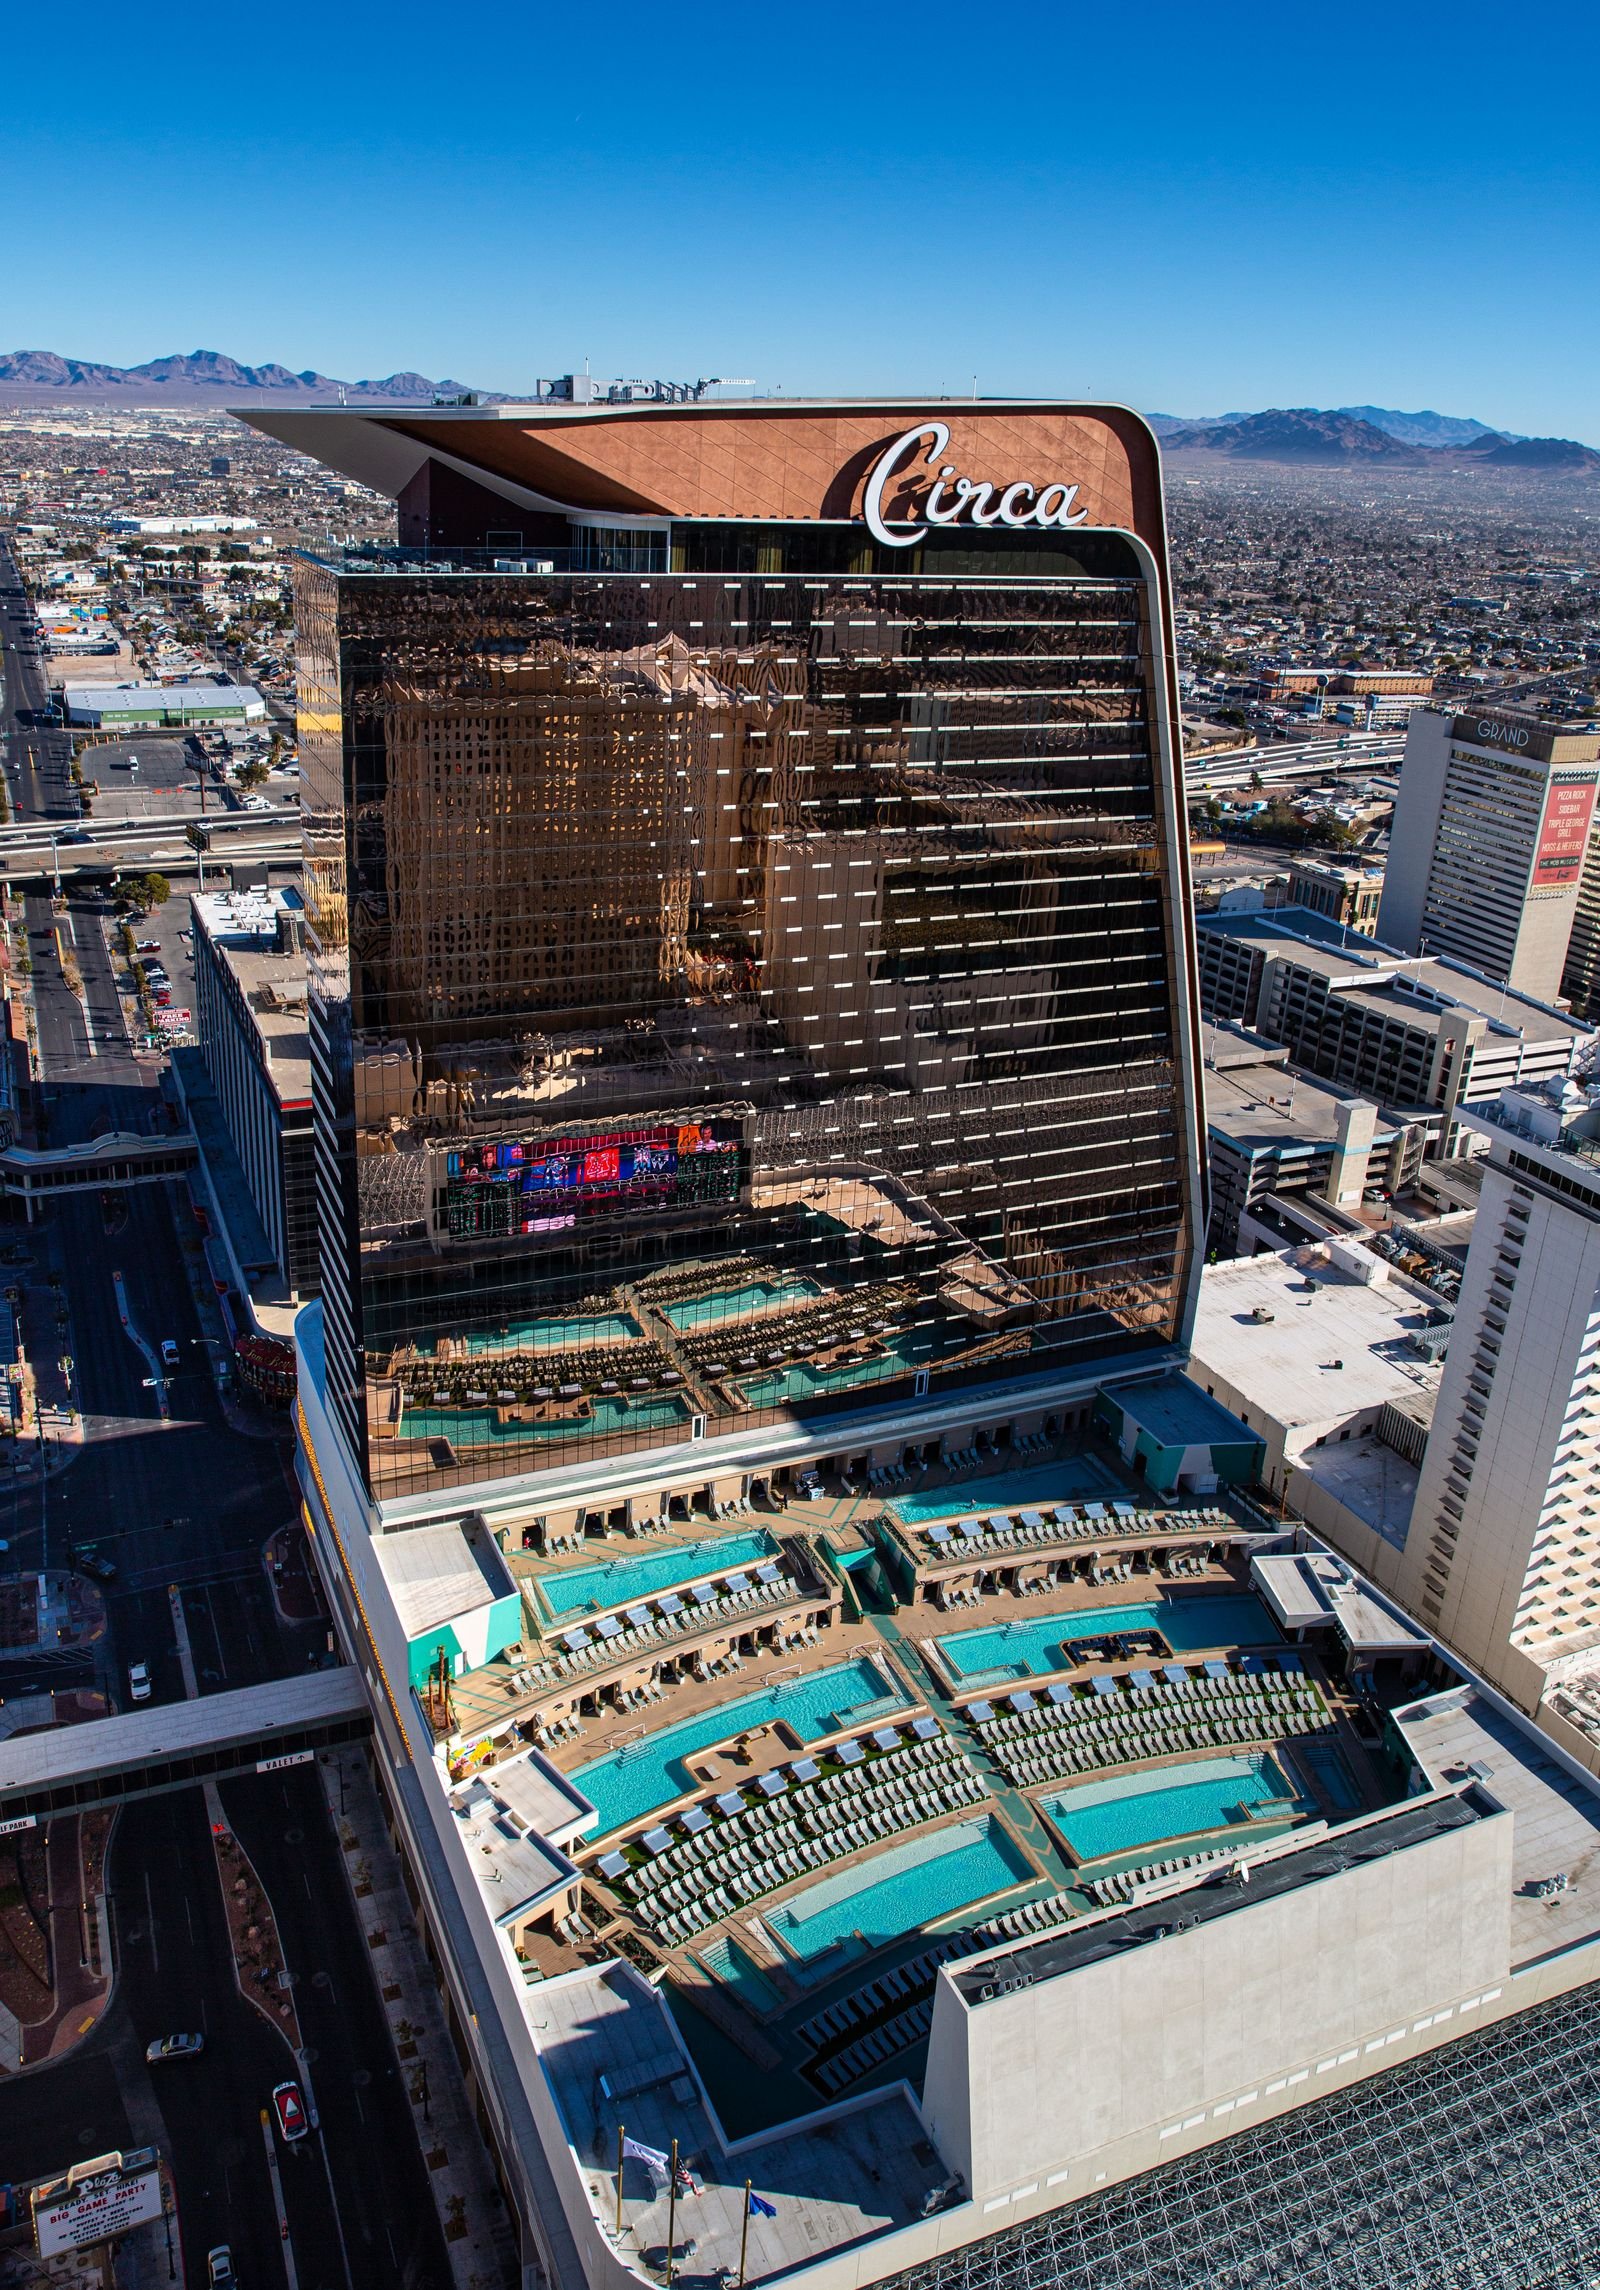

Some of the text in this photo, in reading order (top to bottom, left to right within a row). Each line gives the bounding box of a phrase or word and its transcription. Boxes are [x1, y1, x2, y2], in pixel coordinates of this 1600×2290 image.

[864, 422, 1088, 547] Circa
[1477, 720, 1529, 747] GRAND
[1557, 789, 1587, 801] PIZZA ROCK
[1559, 805, 1580, 814] SIDEBAR
[1548, 817, 1585, 829] TRIPLE GEORGE
[1557, 828, 1571, 838] GRILL
[1561, 840, 1582, 850] HEIFERS
[266, 1756, 294, 1769] VALET
[9, 1820, 27, 1830] PARK
[76, 2171, 122, 2198] Plaza
[50, 2183, 147, 2224] BIG GAME PARTY
[96, 2199, 126, 2213] FEBRUARY
[83, 2220, 104, 2231] SCREEN
[107, 2206, 144, 2222] PROJECTORS
[73, 2215, 131, 2240] BETTING STATIONS
[76, 2232, 101, 2244] TICKETS
